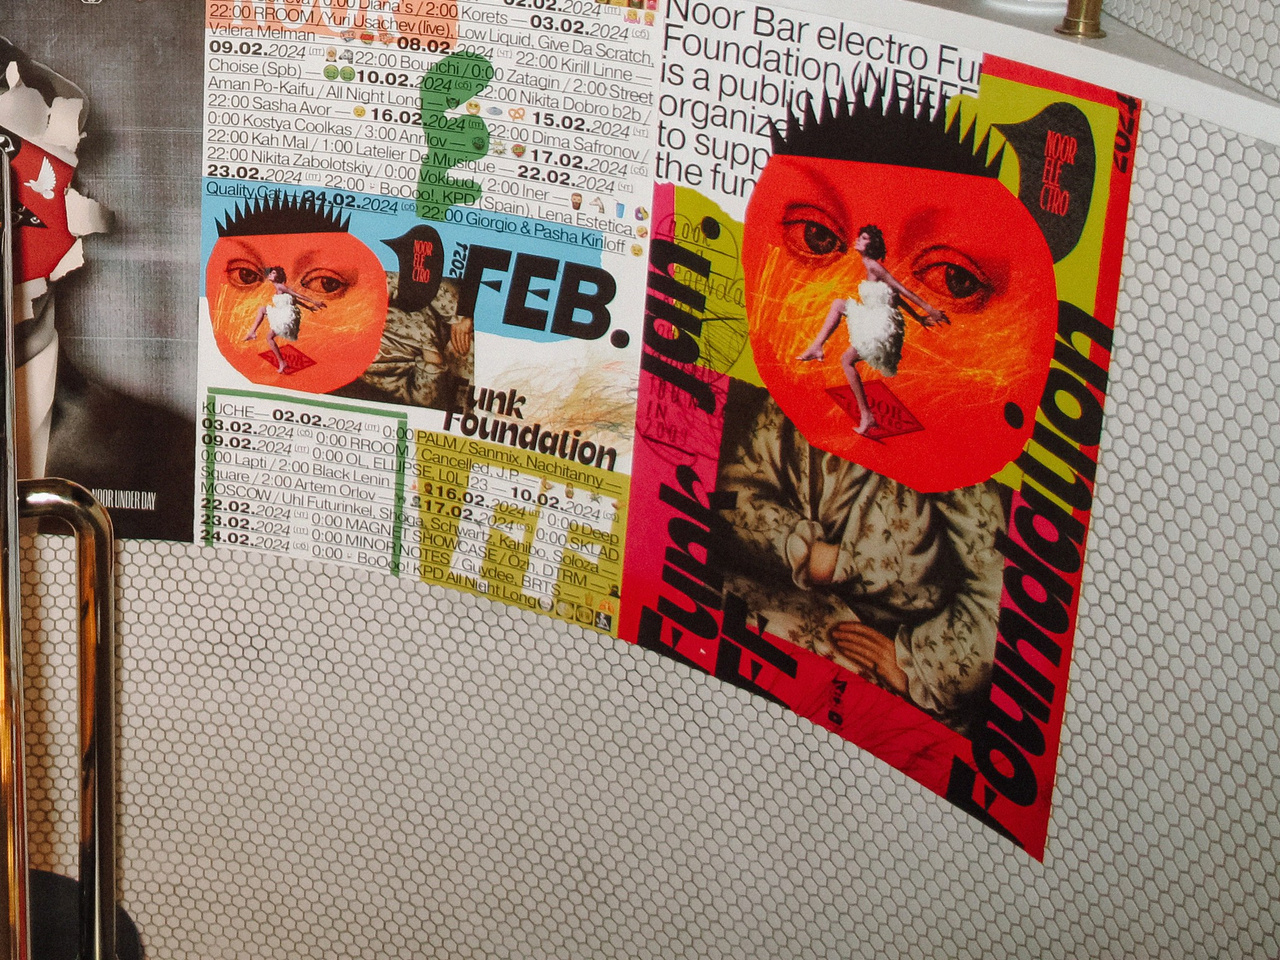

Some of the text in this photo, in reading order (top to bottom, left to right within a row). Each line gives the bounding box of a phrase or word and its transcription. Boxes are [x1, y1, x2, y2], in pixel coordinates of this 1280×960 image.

[664, 23, 840, 86] Foundation
[753, 6, 810, 44] Bar
[818, 22, 928, 70] electro
[660, 55, 684, 86] is
[692, 68, 710, 91] a
[207, 93, 639, 161] 22:00 Sasha Avor 16.02.2024 22:00 Dima Safronov
[243, 114, 628, 177] Kostya Coolkas 3:00 17.02.2024
[657, 120, 686, 150] to
[1044, 130, 1078, 165] NOOR
[656, 151, 702, 186] the
[207, 164, 302, 184] 23.02.2024
[324, 174, 365, 192] 22:00
[442, 190, 475, 207] KPD
[537, 205, 573, 225] Lena
[413, 240, 434, 257] NOOR
[422, 205, 626, 252] 22:00 Giorgio Pasha Kiriloff
[456, 244, 631, 349] FEB.
[462, 385, 527, 420] unk
[444, 411, 617, 472] Foundation
[115, 489, 140, 509] UNDER
[141, 491, 157, 511] DAY
[201, 465, 376, 501] Square 2:00 Artem Orlov
[201, 481, 271, 502] MOSCOW
[200, 512, 561, 596] 23.02.2024 0:00 MINOR NOTES BRTS
[413, 562, 536, 607] KPD All Night Long
